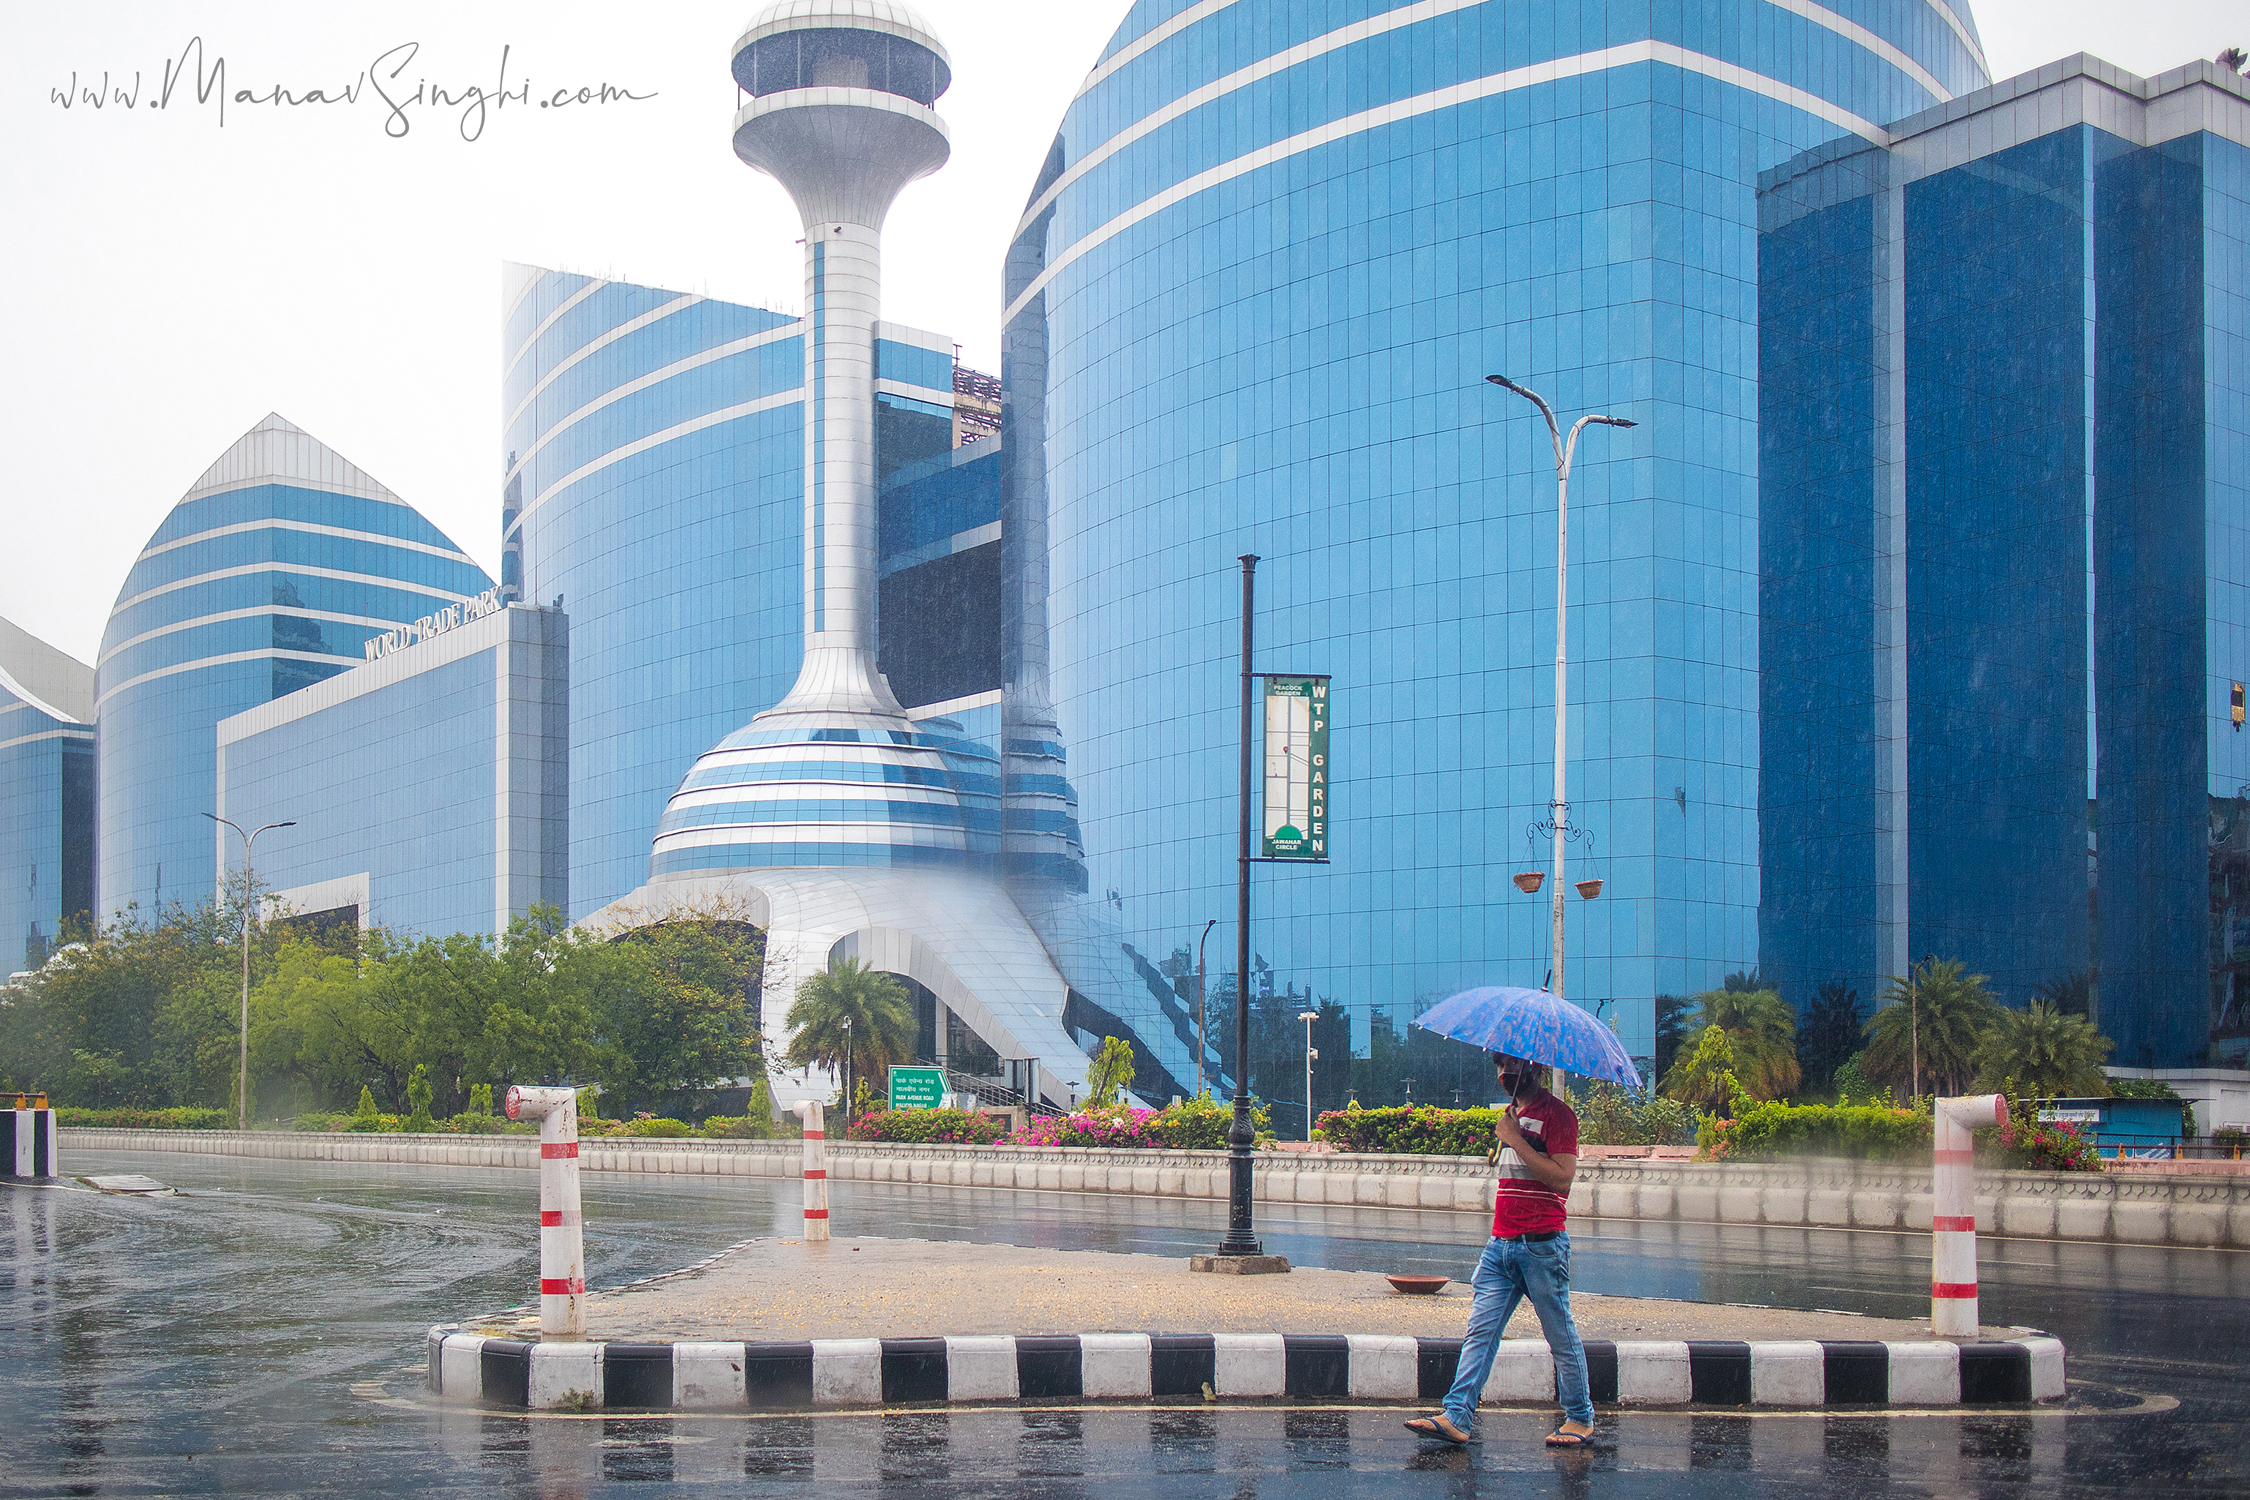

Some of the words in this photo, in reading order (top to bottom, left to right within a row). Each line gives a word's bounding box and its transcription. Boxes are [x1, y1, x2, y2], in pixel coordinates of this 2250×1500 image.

[364, 625, 412, 663] WORLD
[415, 603, 461, 643] TRADE
[464, 585, 502, 625] PARK
[1312, 686, 1326, 732] WTP
[1312, 754, 1324, 852] GARDEN
